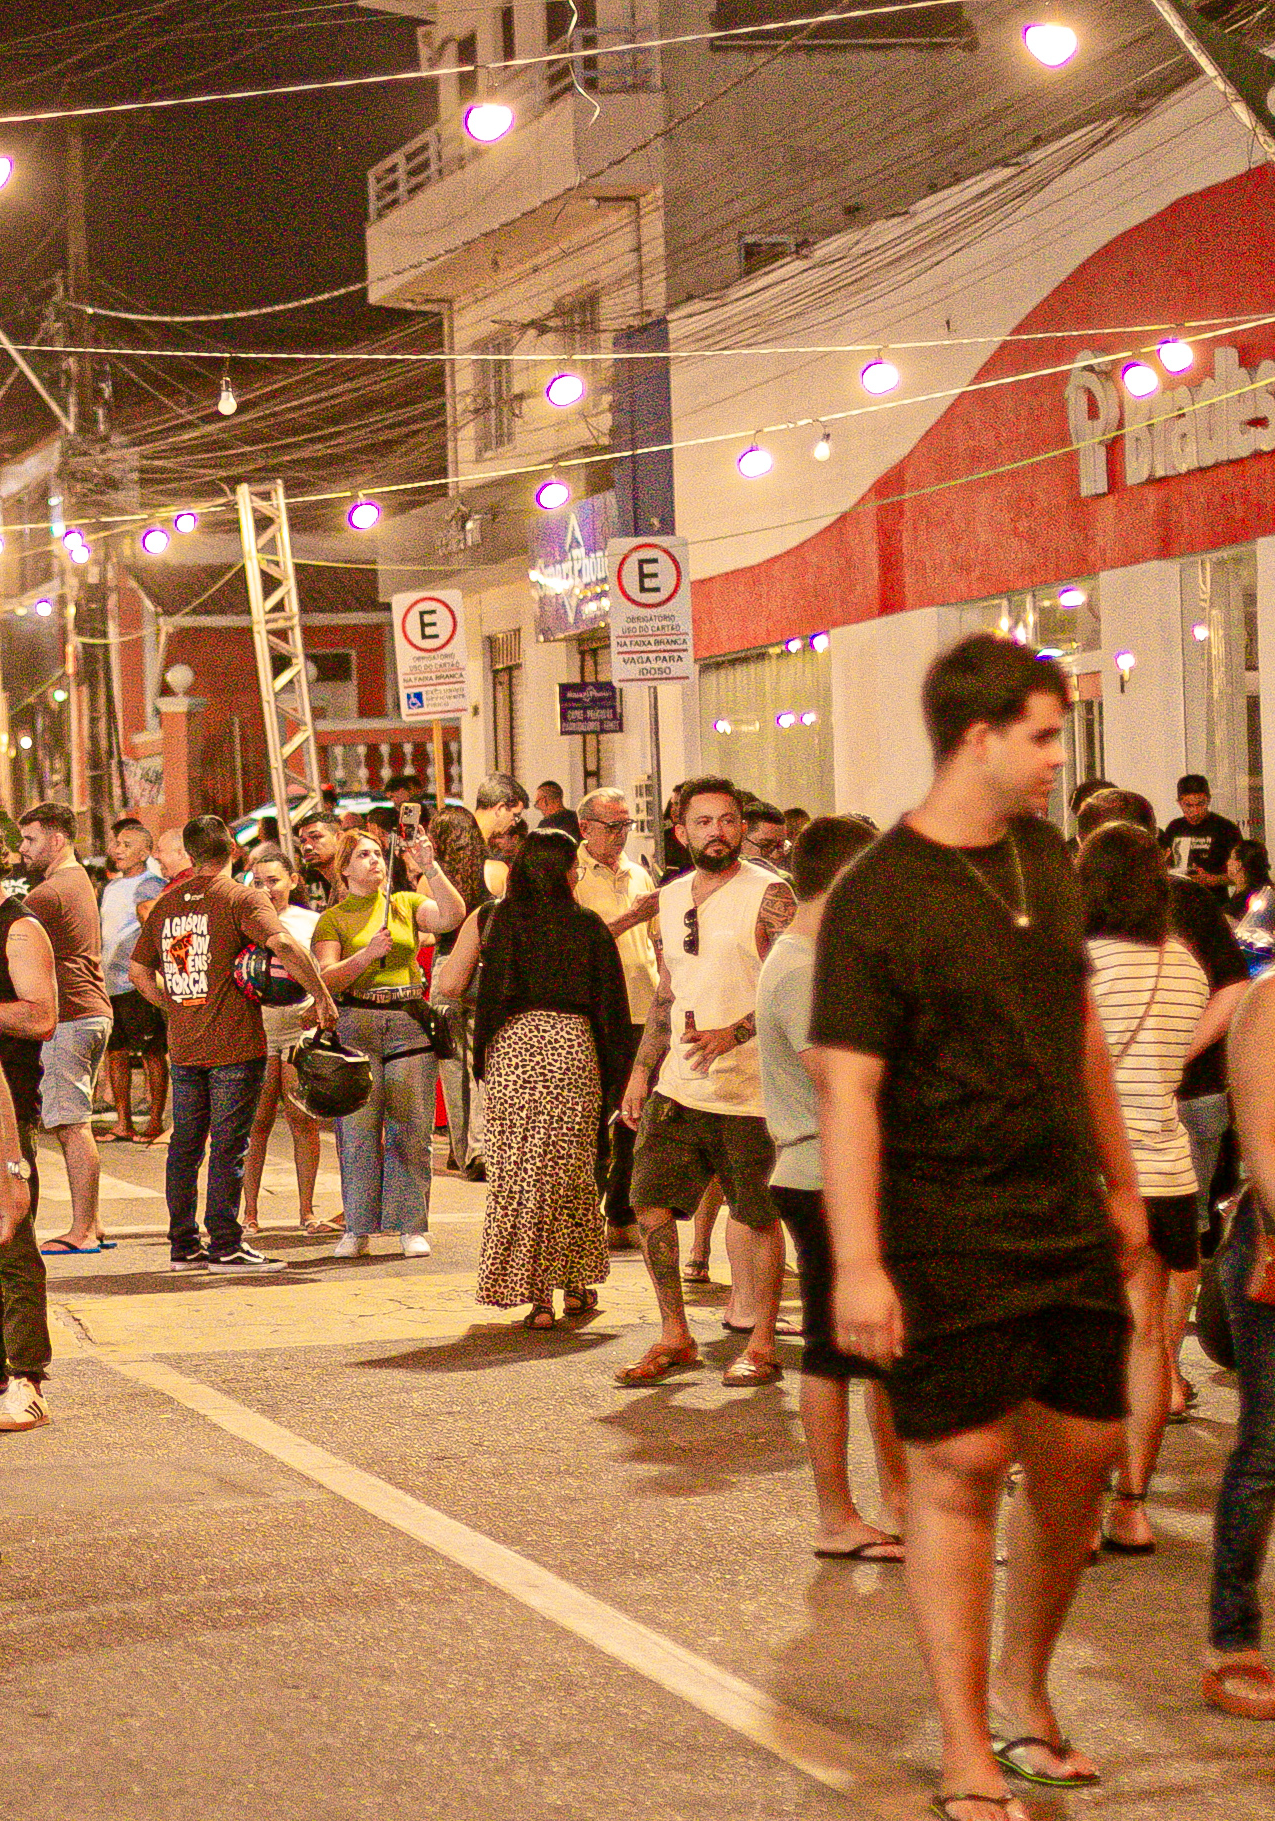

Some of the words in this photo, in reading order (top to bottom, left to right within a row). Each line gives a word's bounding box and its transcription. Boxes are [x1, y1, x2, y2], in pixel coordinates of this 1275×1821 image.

[638, 558, 661, 593] E
[419, 609, 439, 640] E
[616, 640, 628, 648] NA
[629, 639, 653, 648] FAIXA
[654, 638, 688, 647] BRANCA
[622, 655, 652, 665] VAGA
[654, 654, 684, 664] PARA
[638, 666, 672, 676] IDOSO
[165, 971, 209, 998] FORÇA
